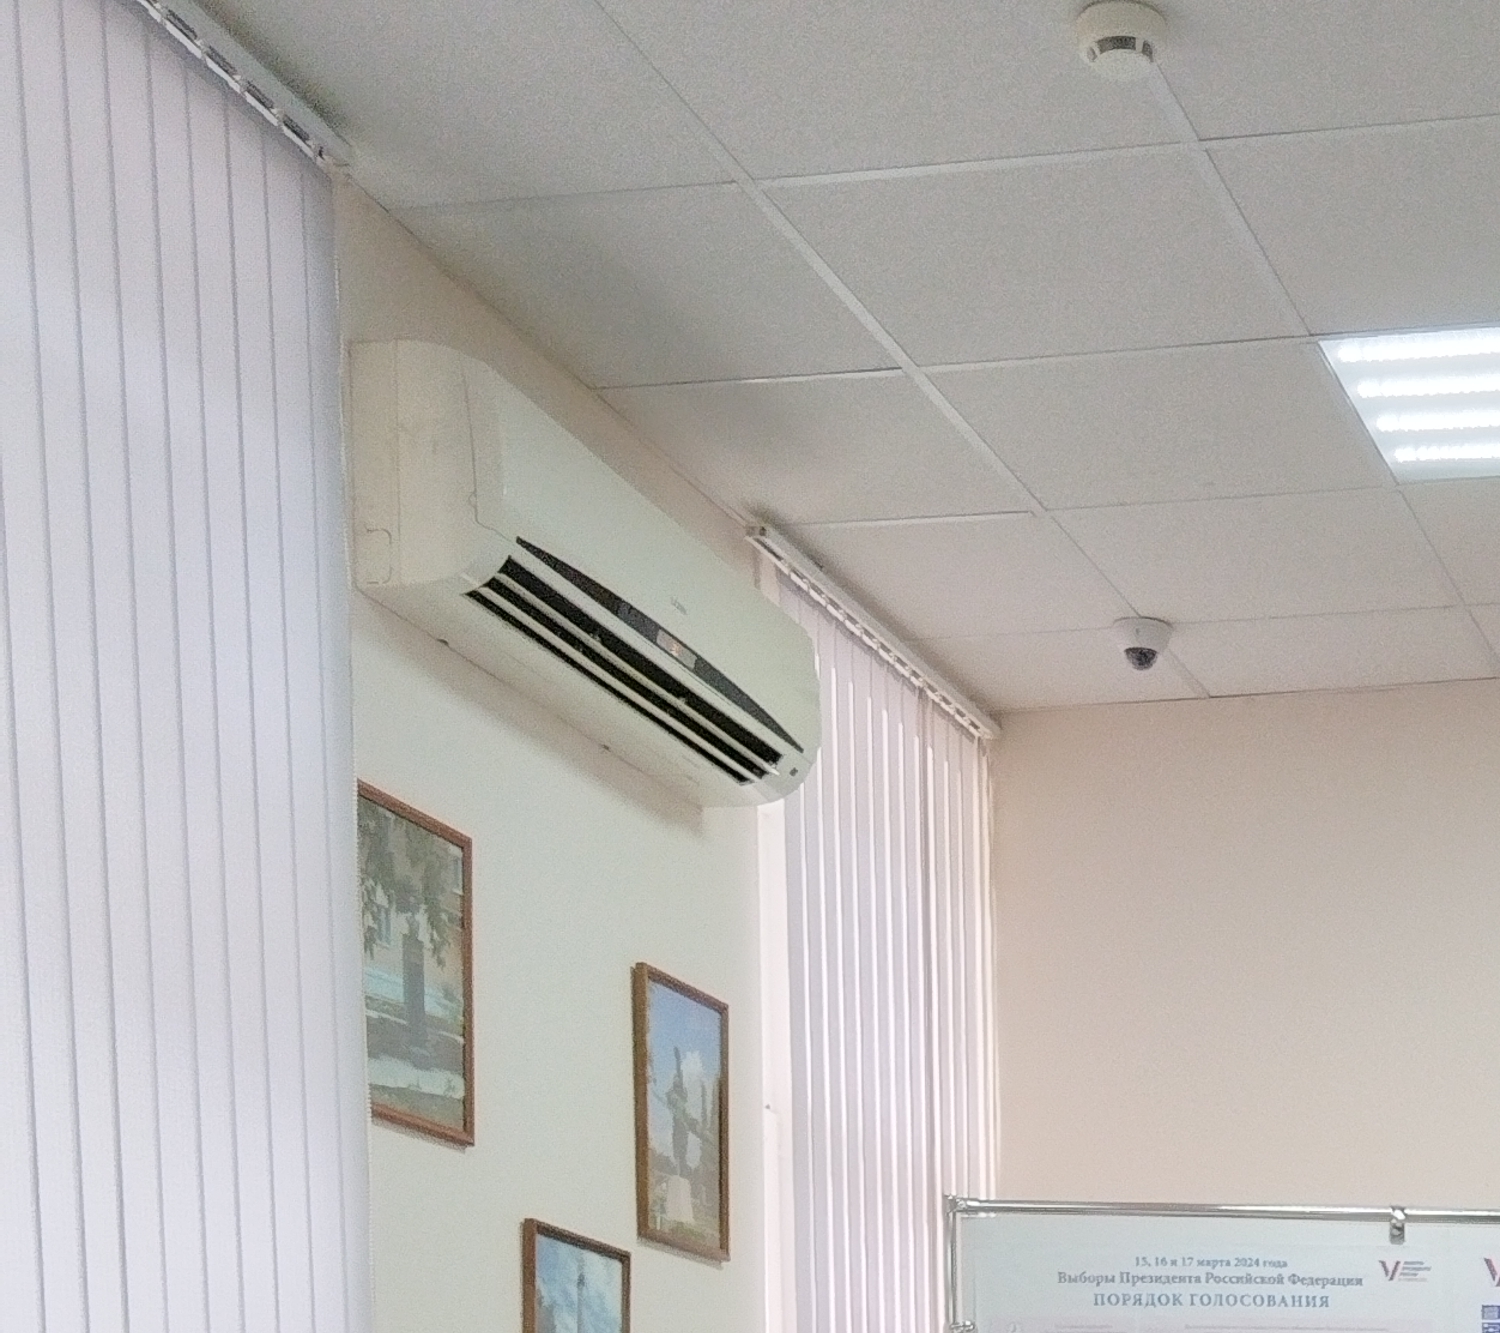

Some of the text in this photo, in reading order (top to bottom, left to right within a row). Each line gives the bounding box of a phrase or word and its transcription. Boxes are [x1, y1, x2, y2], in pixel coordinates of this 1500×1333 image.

[1135, 1256, 1288, 1270] 15, 16 и 17 марта 2024 года
[1057, 1271, 1116, 1287] Выборы
[1119, 1271, 1201, 1287] Президента
[1205, 1271, 1284, 1286] Российской
[1093, 1293, 1330, 1308] ПОРЯДОК ГОЛОСОВАНИЯ
